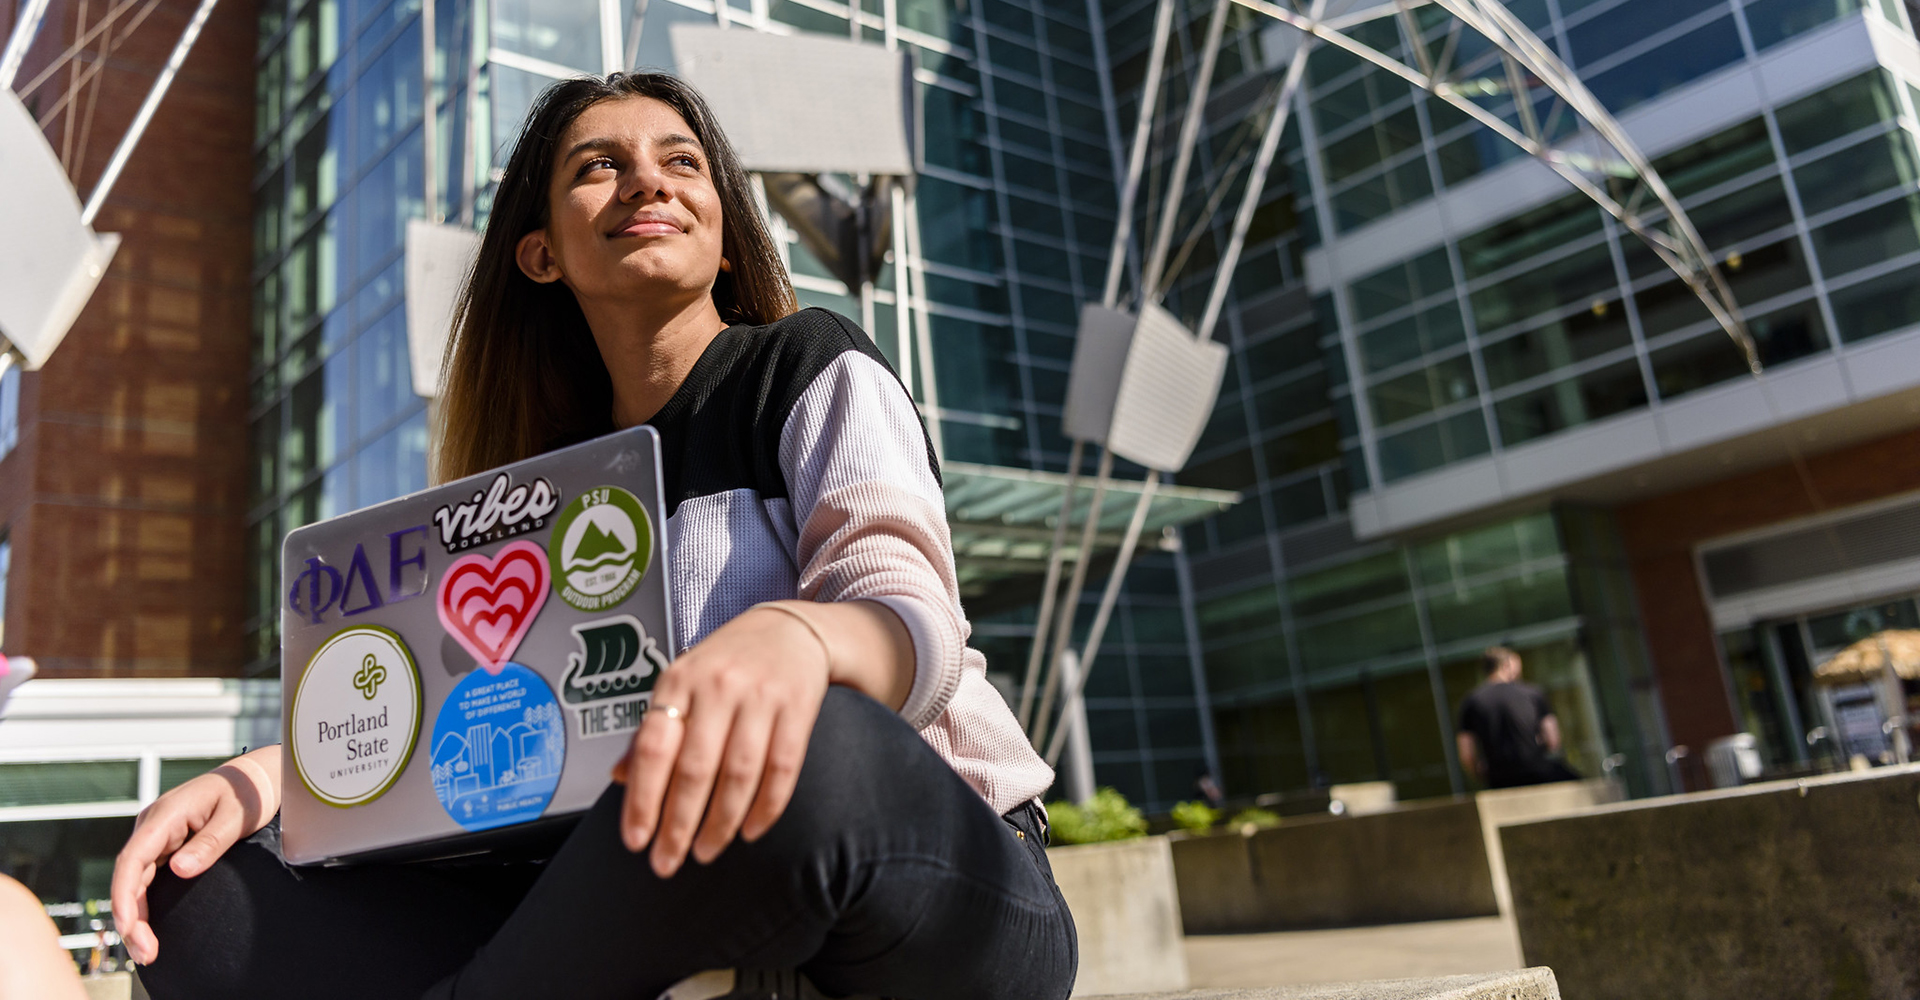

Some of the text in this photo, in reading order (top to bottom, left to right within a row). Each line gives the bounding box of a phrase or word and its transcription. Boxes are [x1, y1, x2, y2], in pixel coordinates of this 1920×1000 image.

[435, 474, 558, 544] vibes
[582, 489, 610, 509] PSU
[449, 519, 544, 551] PORTLAND
[561, 568, 642, 609] OUTDOOR PROGRAM
[459, 687, 527, 711] TO MAKE A WORLD
[465, 678, 519, 699] A GREAT PLACE
[465, 700, 521, 720] OF DIFFERENCE
[580, 705, 609, 735] THE
[318, 705, 388, 743] Portland
[347, 737, 389, 761] State
[330, 759, 389, 779] UNIVERSITY
[497, 802, 518, 812] PUBLIC
[519, 796, 542, 807] HEALTH
